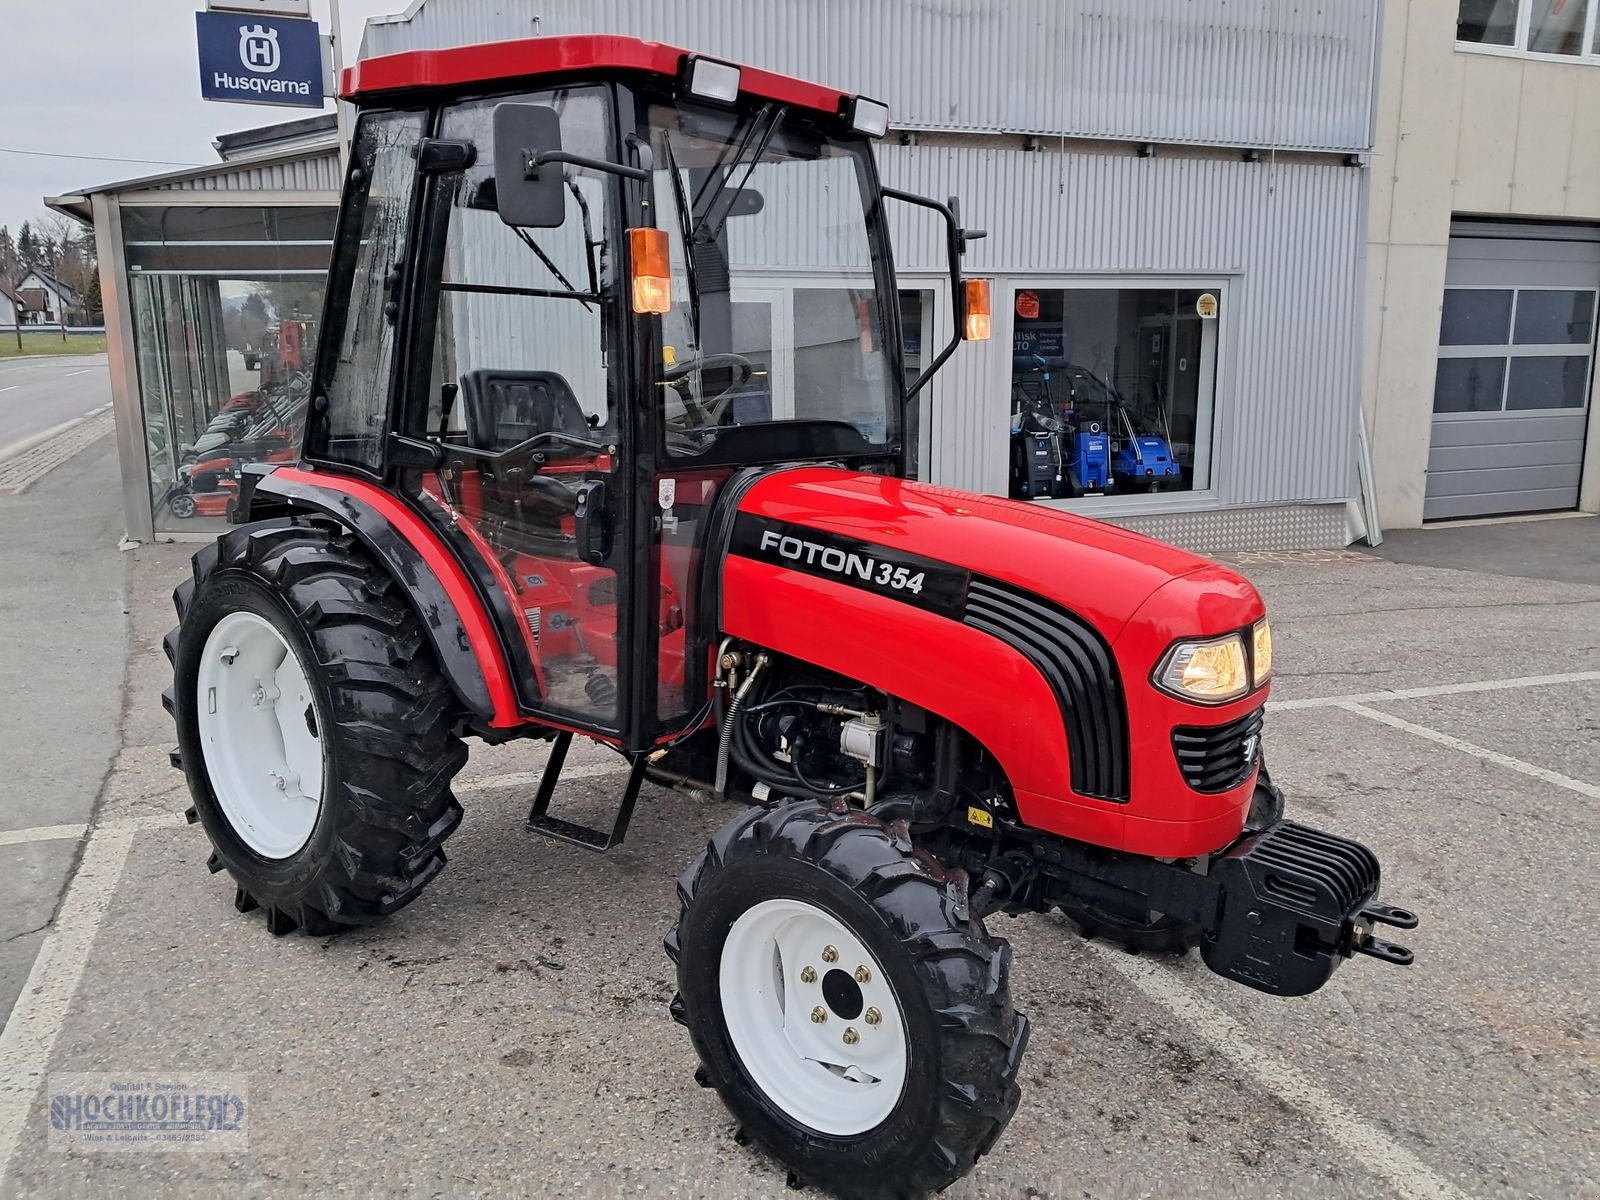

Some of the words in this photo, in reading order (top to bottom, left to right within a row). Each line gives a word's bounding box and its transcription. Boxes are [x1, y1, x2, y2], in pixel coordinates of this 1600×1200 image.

[214, 72, 310, 95] Husqvarna
[760, 530, 875, 581] FOTON
[875, 563, 926, 594] 354
